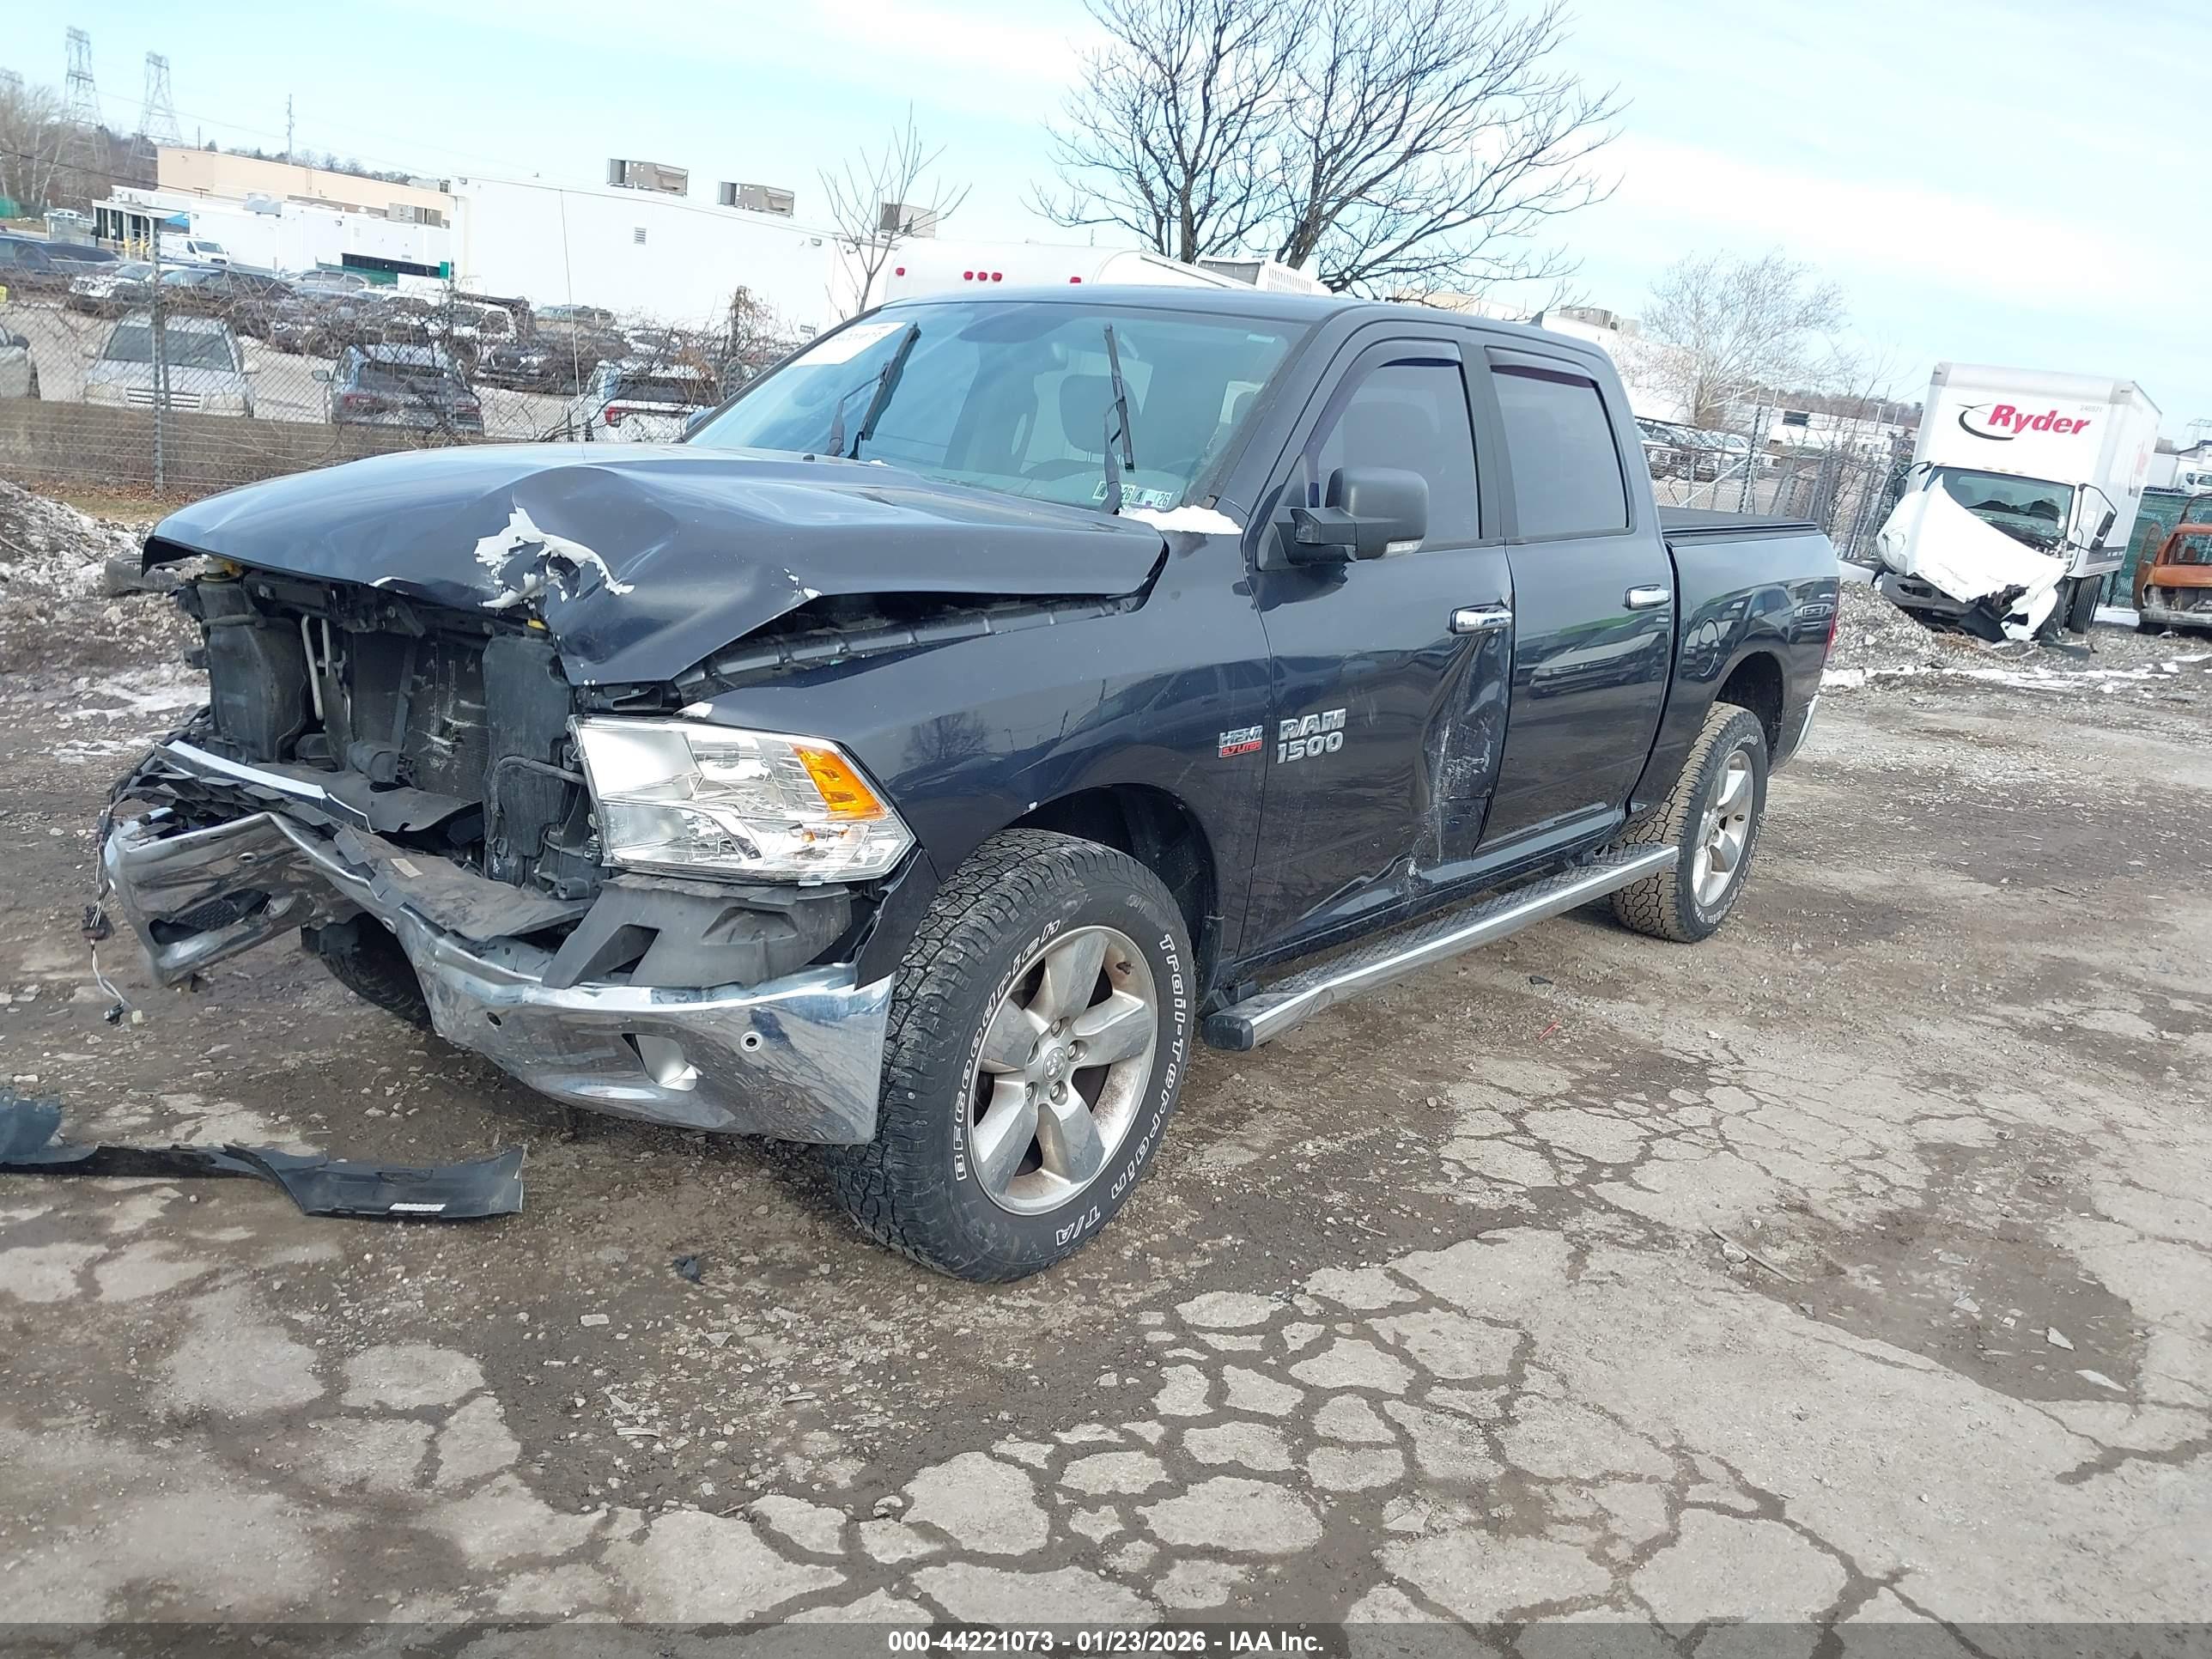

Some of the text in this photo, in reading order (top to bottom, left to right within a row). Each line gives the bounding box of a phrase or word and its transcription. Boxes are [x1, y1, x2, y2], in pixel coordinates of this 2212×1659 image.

[1988, 404, 2092, 434] Ryder
[1157, 493, 1170, 506] 26
[1219, 725, 1263, 746] HEMI
[1278, 708, 1346, 741] RAM
[1222, 744, 1236, 756] 5.7
[1277, 731, 1344, 764] 1500
[953, 919, 1060, 1182] BFGoodrich
[1055, 933, 1187, 1246] Trail-Terrain T/A
